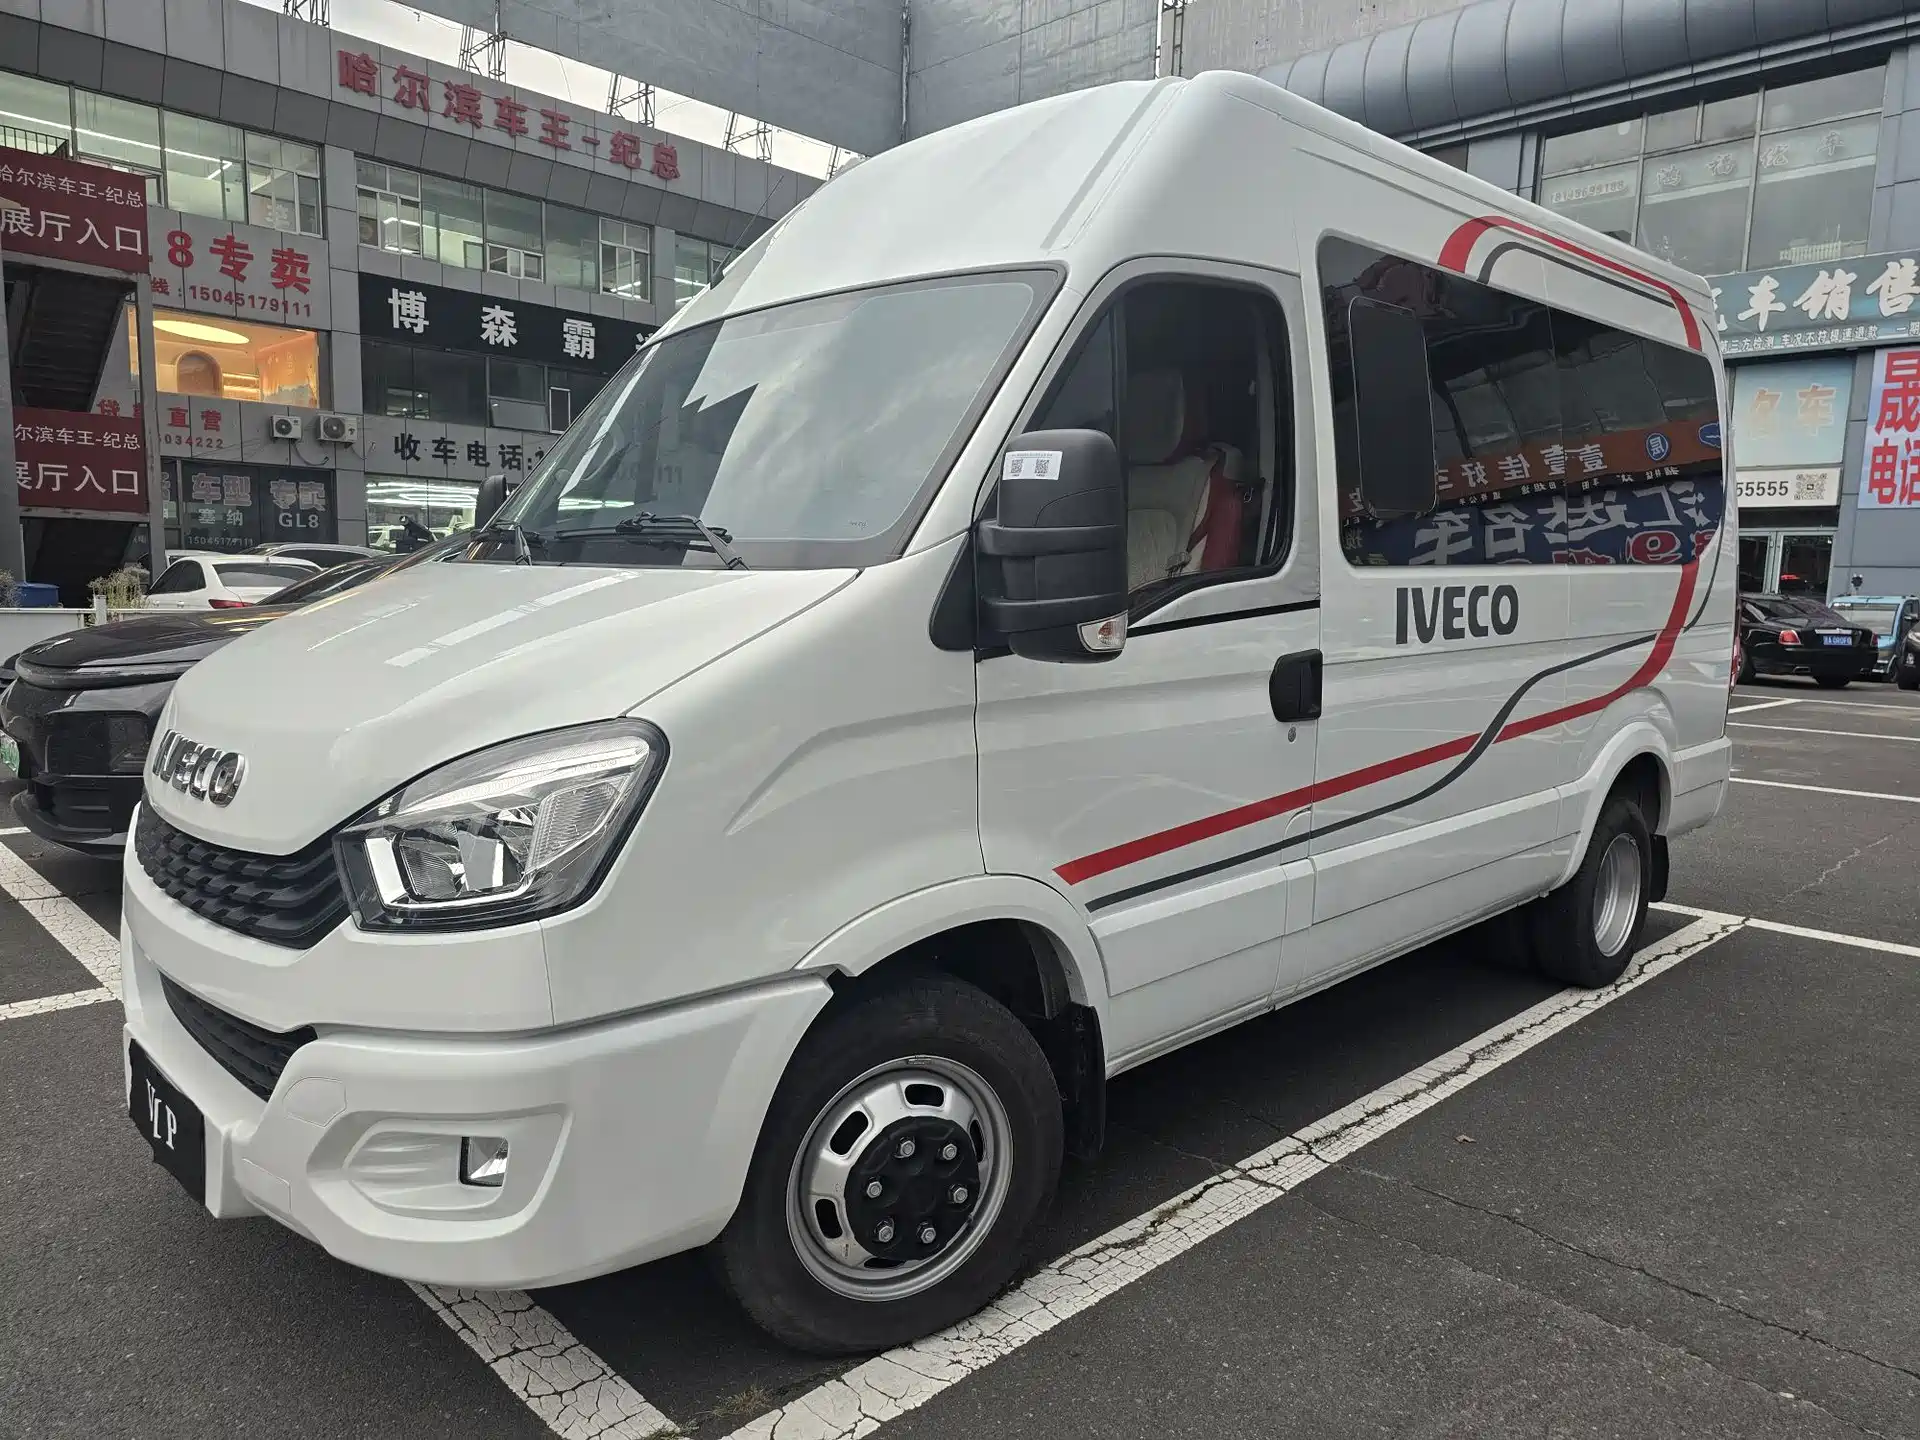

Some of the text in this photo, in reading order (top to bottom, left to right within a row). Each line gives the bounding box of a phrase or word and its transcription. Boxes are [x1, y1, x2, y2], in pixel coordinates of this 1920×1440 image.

[338, 50, 681, 181] 哈尔滨车王-纪总
[0, 164, 144, 208] 哈尔滨车王-纪总
[0, 207, 142, 255] 展厅入口
[149, 230, 311, 295] 8专卖
[388, 288, 654, 360] 博森霸
[278, 512, 320, 528] GL8
[1396, 584, 1519, 645] IVECO
[152, 729, 246, 808] IVECO
[145, 1078, 178, 1151] VIP
